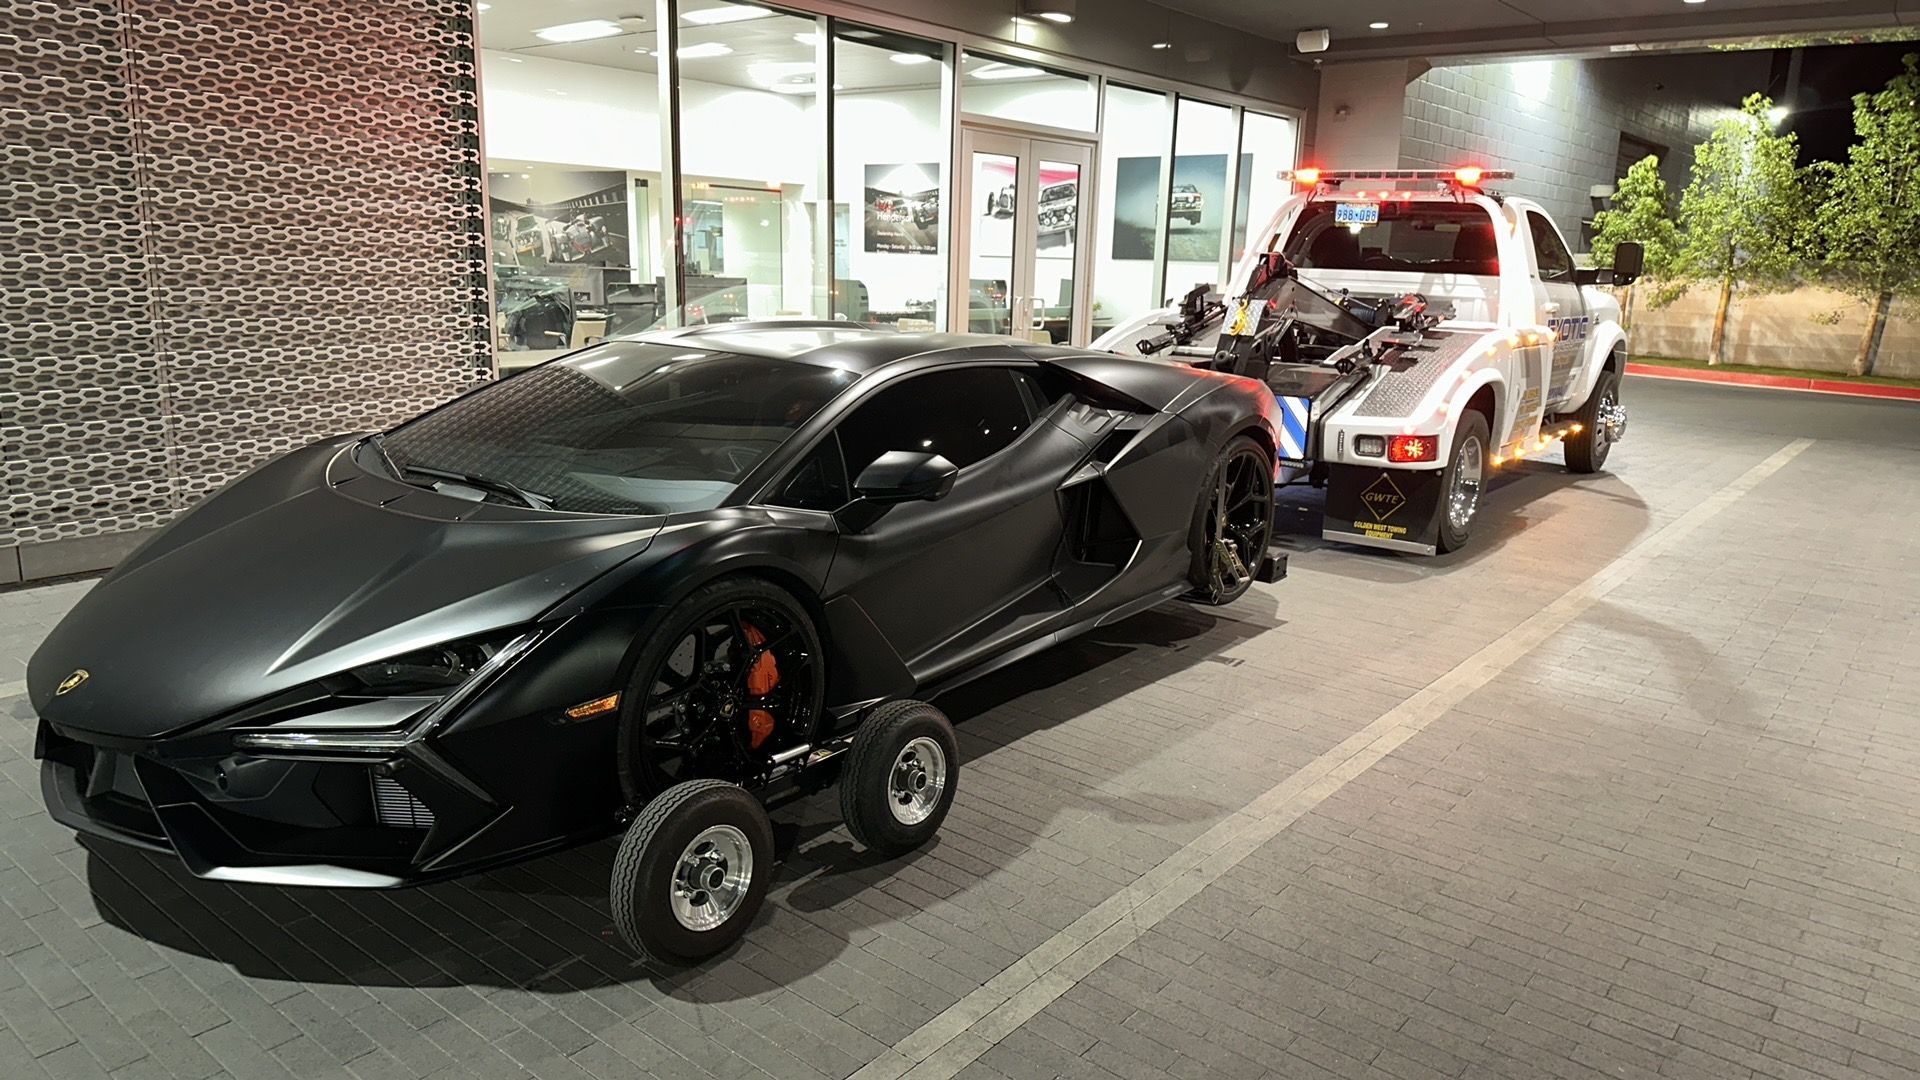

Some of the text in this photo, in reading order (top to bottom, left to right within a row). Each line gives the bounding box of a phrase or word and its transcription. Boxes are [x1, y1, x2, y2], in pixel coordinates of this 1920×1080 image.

[1548, 317, 1588, 341] EXOTIC
[1365, 492, 1399, 505] GWTE
[1354, 521, 1407, 534] GOLDEN WEST TOWING
